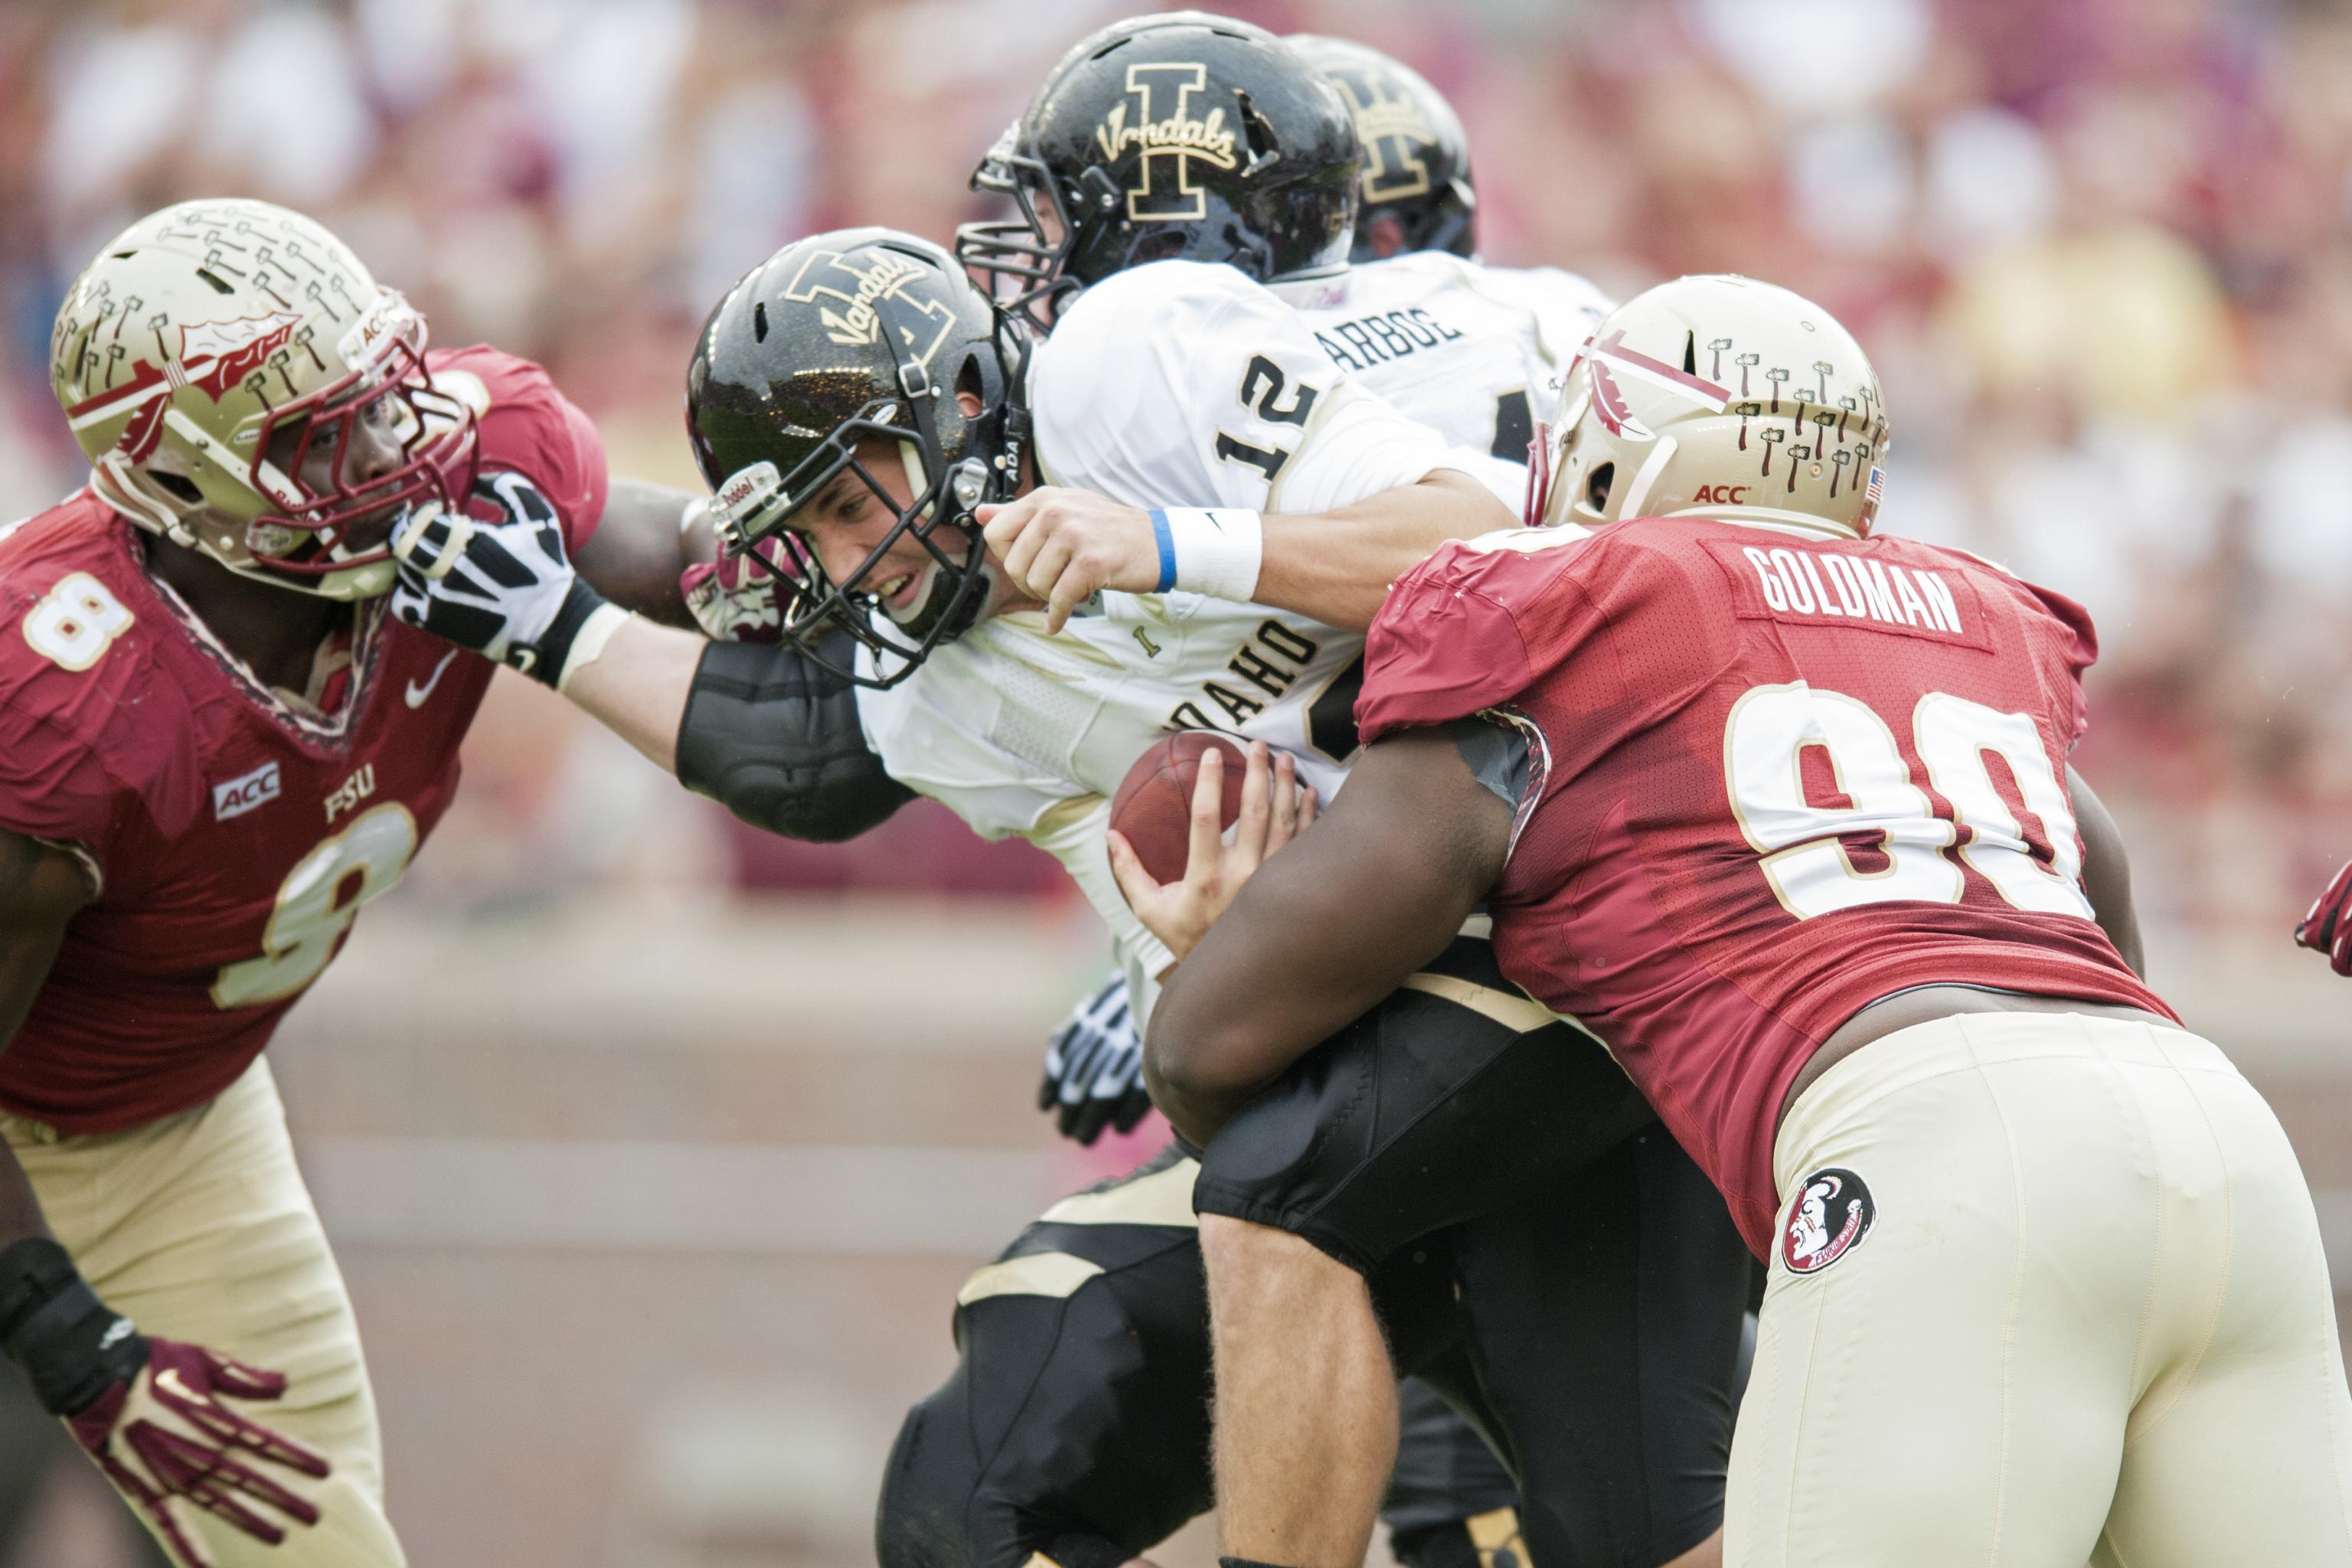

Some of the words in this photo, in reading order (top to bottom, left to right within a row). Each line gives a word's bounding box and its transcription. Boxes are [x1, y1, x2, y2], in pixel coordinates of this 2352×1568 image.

[820, 252, 928, 345] Vandals
[1213, 351, 1319, 485] 12
[1693, 485, 1746, 505] ACC
[22, 571, 136, 672] 8
[1743, 547, 1964, 635] GOLDMAN
[1161, 619, 1318, 733] DAHO
[220, 768, 277, 814] ACC
[324, 763, 376, 825] FSU
[1723, 679, 2096, 922] 90
